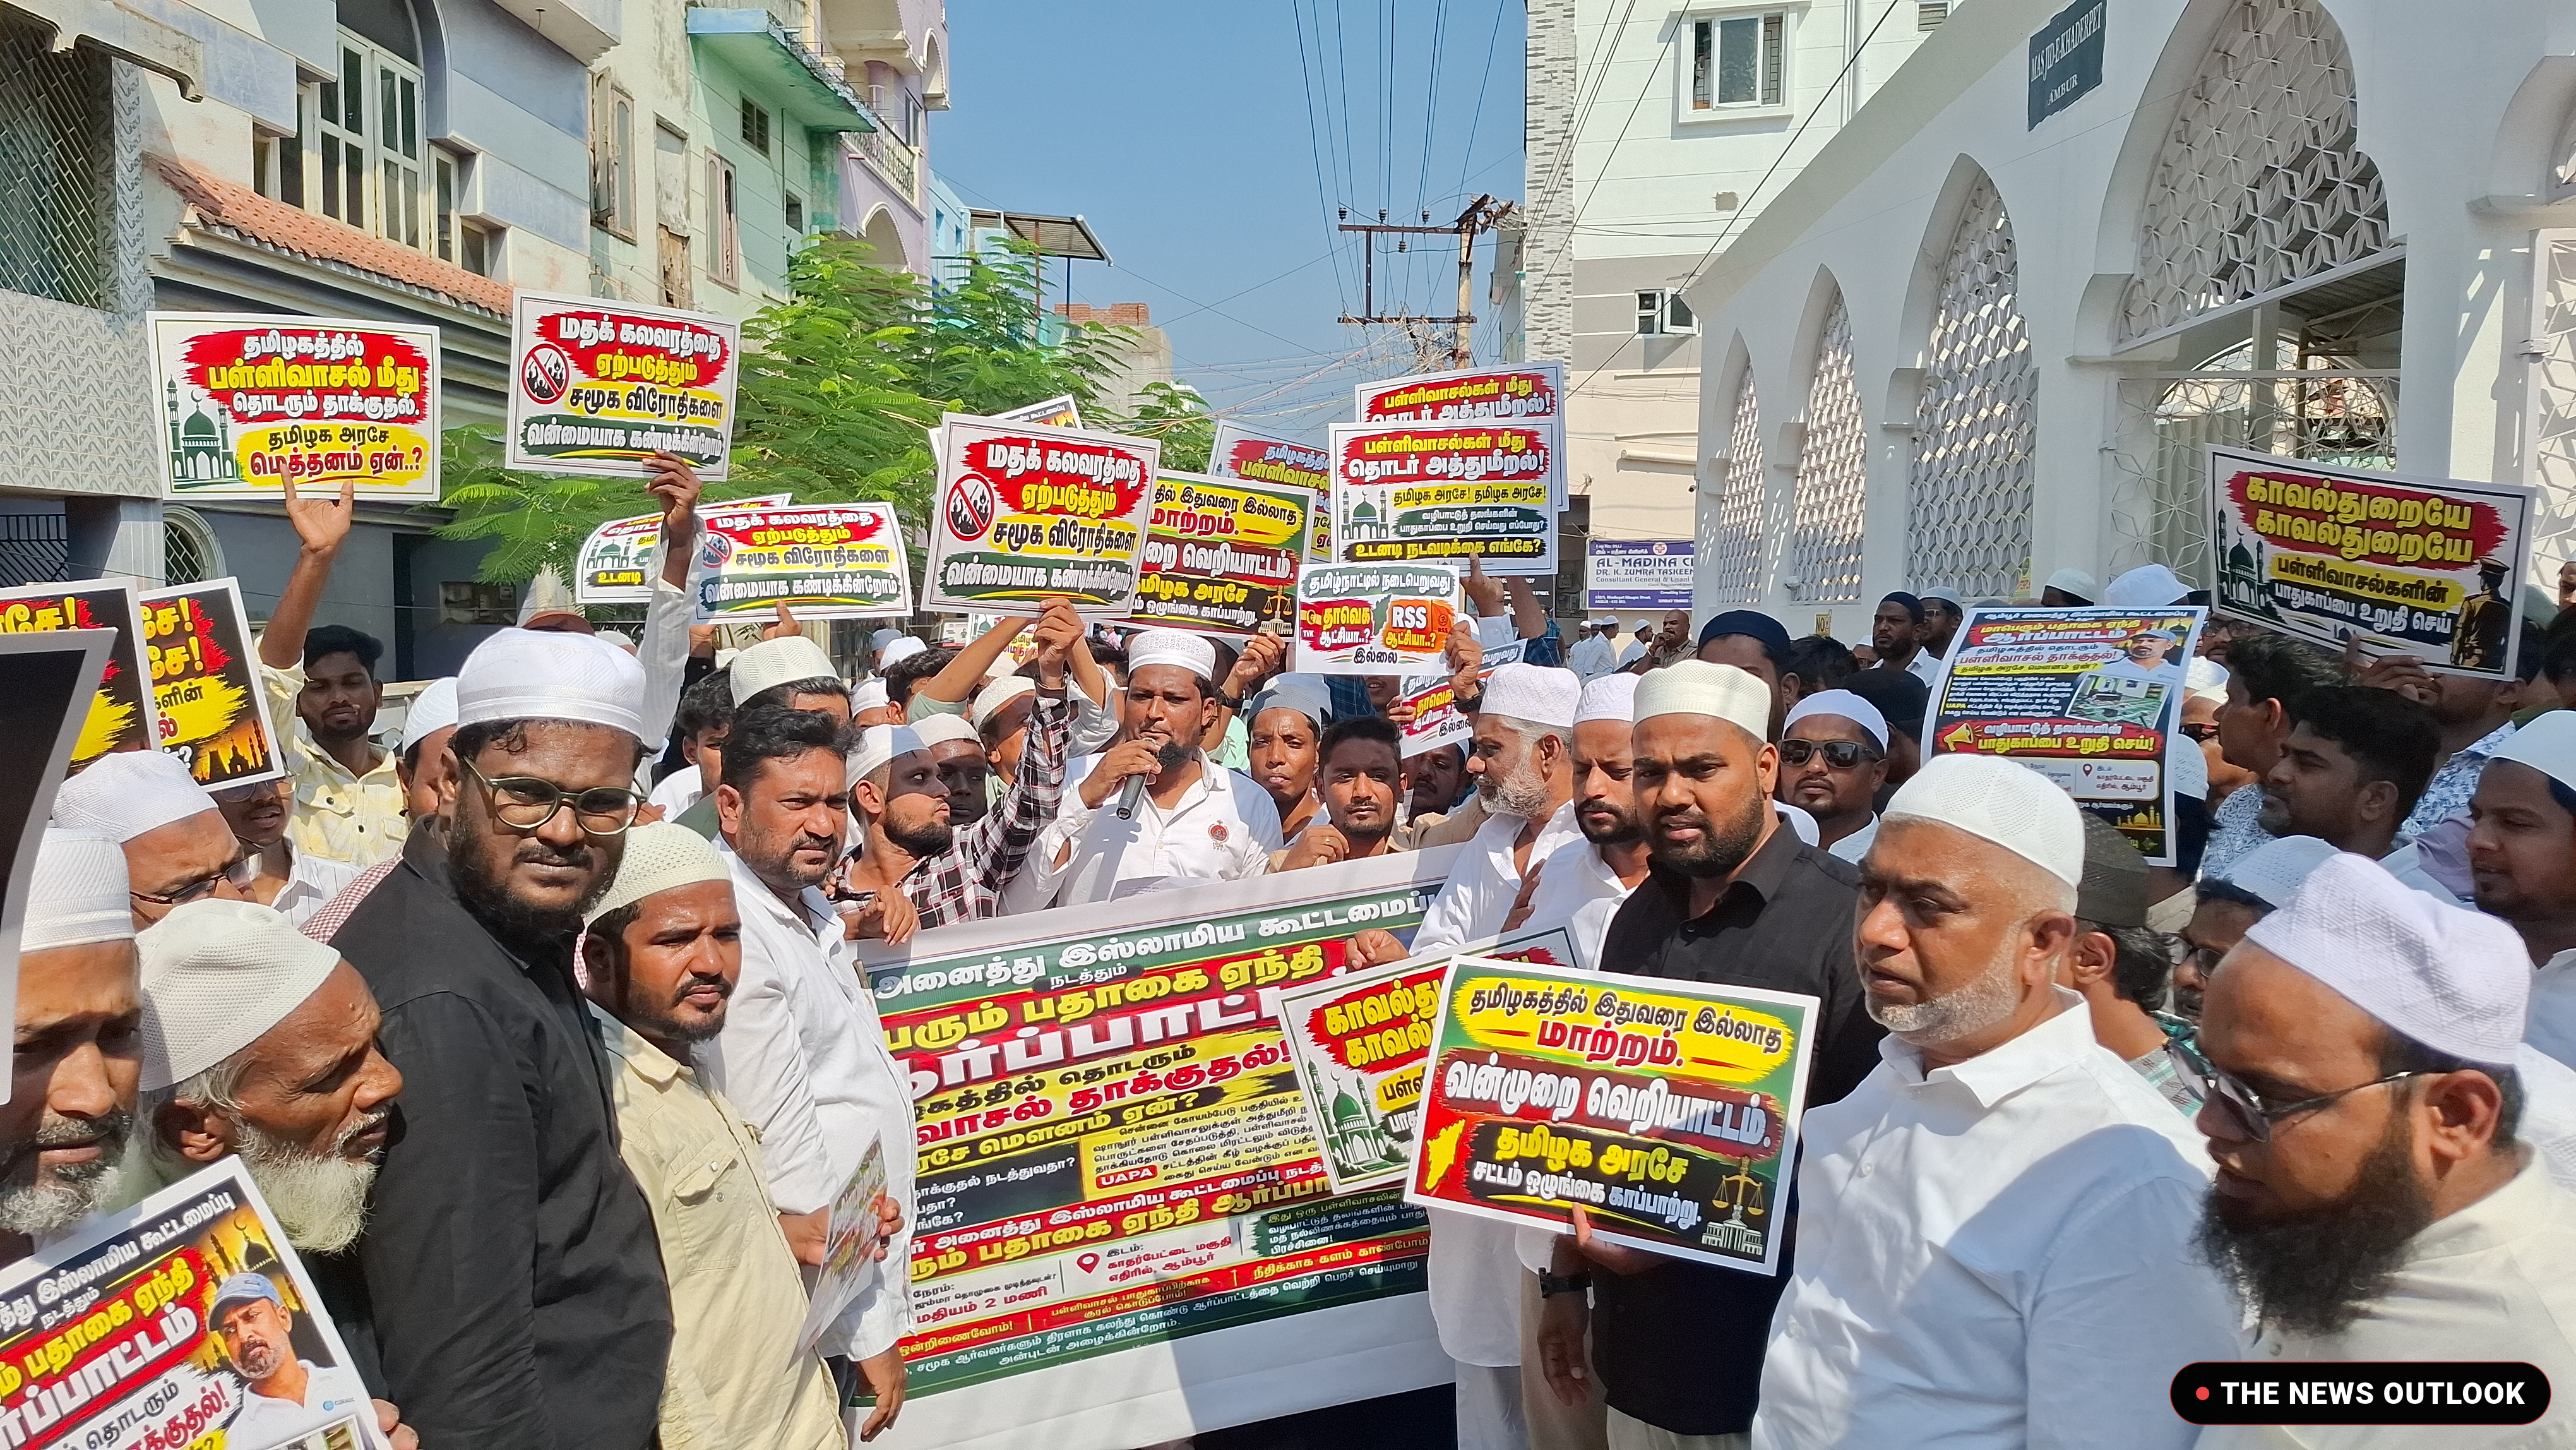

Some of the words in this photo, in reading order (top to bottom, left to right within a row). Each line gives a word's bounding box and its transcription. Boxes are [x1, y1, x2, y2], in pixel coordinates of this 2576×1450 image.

[2031, 2, 2102, 82] MASJID-E-KHADERPET
[2047, 74, 2078, 105] AMBUR
[244, 330, 364, 360] தமிழகத்தில்
[559, 315, 615, 348] மதக்
[620, 324, 722, 362] கலவரத்தை
[208, 356, 371, 390] பள்ளிவாசல்
[377, 355, 420, 395] மீது
[595, 349, 698, 387] ஏற்படுத்தும்
[232, 390, 317, 417] தொடரும்
[323, 390, 420, 419] தாக்குதல்.
[569, 386, 620, 414] சமூக
[626, 385, 724, 421] விரோதிகளை
[1385, 378, 1500, 409] பள்ளிவாசல்கள்
[1505, 376, 1532, 396] மீது
[1438, 392, 1551, 420] அத்துமீறல்!
[268, 425, 333, 451] தமிழக
[339, 426, 389, 444] அரசே
[527, 417, 626, 446] வன்மையாக
[630, 424, 724, 460] கண்டிக்கின்றோம்
[1364, 431, 1491, 453] பள்ளிவாசல்கள்
[1498, 431, 1525, 452] மீது
[251, 445, 363, 477] மெத்தனம்
[987, 440, 1042, 477] மதக்
[1046, 450, 1141, 488] கலவரத்தை
[1348, 453, 1419, 482] தொடர்
[1425, 450, 1544, 480] அத்துமீறல்!
[1022, 477, 1117, 518] ஏற்படுத்தும்
[1180, 487, 1239, 513] இதுவரை
[1243, 497, 1297, 524] இல்லாத
[1393, 488, 1431, 506] தமிழக
[1434, 486, 1470, 500] அரசே!
[1474, 486, 1508, 503] தமிழக
[1513, 486, 1546, 499] அரசே!
[2246, 475, 2472, 530] காவல்துறையே
[717, 510, 765, 530] மதக்
[768, 510, 874, 527] கலவரத்தை
[1400, 521, 1448, 534] பாதுகாப்பை
[1450, 522, 1472, 533] உறுதி
[1474, 522, 1507, 532] செய்வது
[1422, 509, 1468, 521] வழிபாட்டுத்
[1470, 510, 1517, 520] தலங்களின்
[753, 524, 852, 545] ஏற்படுத்தும்
[993, 522, 1044, 551] சமூக
[1048, 518, 1136, 556] விரோதிகளை
[1356, 542, 1402, 557] உடனடி
[1407, 539, 1485, 559] நடவடிக்கை
[1489, 539, 1541, 553] எங்கே?
[2256, 508, 2473, 563] காவல்துறையே
[736, 549, 779, 568] சமூக
[785, 546, 890, 568] விரோதிகளை
[947, 554, 1047, 587] வன்மையாக
[598, 572, 641, 585] உடனடி
[705, 575, 789, 604] வன்மையாக
[793, 573, 897, 600] கண்டிக்கின்றோம்
[1195, 582, 1248, 603] அரசே
[1309, 570, 1380, 596] தமிழ்நாட்டில்
[1381, 572, 1451, 597] நடைபெறுவது
[2277, 556, 2449, 604] பள்ளிவாசல்களின்
[1147, 599, 1198, 615] ஒழுங்கை
[1392, 606, 1427, 628] RSS
[2274, 582, 2354, 617] பாதுகாப்பை
[2359, 604, 2407, 633] உறுதி
[2412, 611, 2451, 634] செய்
[1977, 645, 2044, 654] தமிழகத்தில்
[2049, 644, 2098, 652] தொடரும்
[1982, 628, 2127, 644] ஆர்ப்பாட்டம்
[1354, 646, 1398, 665] இல்லை
[1960, 652, 2044, 664] பள்ளிவாசல்
[1978, 735, 2061, 753] பாதுகாப்பை
[2066, 736, 2109, 753] உறுதி
[2113, 735, 2154, 752] செய்!
[1984, 722, 2051, 736] வழிபாட்டுத்
[2053, 722, 2122, 734] தலங்களின்
[874, 955, 1047, 999] அனைத்து
[1058, 921, 1245, 968] இஸ்லாமிய
[1023, 968, 1208, 1023] பதாகை
[1220, 944, 1324, 991] ஏந்தி
[1051, 963, 1127, 990] நடத்தும்
[1469, 981, 1587, 1017] தமிழகத்தில்
[1594, 992, 1688, 1033] இதுவரை
[1693, 1006, 1782, 1053] இல்லாத
[1536, 1019, 1684, 1068] மாற்றம்.
[1059, 1043, 1196, 1086] தொடரும்
[1070, 1041, 1292, 1116] தாக்குதல்!
[1123, 1092, 1199, 1127] ஏன்?
[1174, 1107, 1236, 1125] கோயம்பேடு
[1241, 1097, 1288, 1113] பகுதியில்
[1445, 1052, 1582, 1122] வன்முறை
[1586, 1077, 1771, 1148] வெறியாட்டம்.
[1094, 1142, 1167, 1163] பொருட்களை
[1244, 1115, 1306, 1133] பள்ளிவாசல்
[1142, 1117, 1241, 1142] பள்ளிவாசலுக்குள்
[1095, 1153, 1167, 1175] தாக்கியதோடு
[1220, 1131, 1273, 1147] மிரட்டலும்
[1162, 1153, 1217, 1171] சட்டத்தின்
[1496, 1124, 1592, 1170] தமிழக
[1599, 1143, 1689, 1183] அரசே
[986, 1157, 1075, 1186] நடத்துவதா?
[1100, 1169, 1153, 1185] UAPA
[934, 1217, 1041, 1250] அனைத்து
[1049, 1192, 1166, 1226] இஸ்லாமிய
[1169, 1169, 1280, 1201] கூட்டமைப்பு
[1321, 1192, 1400, 1212] பள்ளிவாசலின்
[1473, 1159, 1522, 1187] சட்டம்
[1526, 1171, 1606, 1204] ஒழுங்கை
[1608, 1185, 1702, 1229] காப்பாற்று.
[979, 1220, 1111, 1262] பதாகை
[1120, 1195, 1200, 1236] ஏந்தி
[37, 1237, 141, 1305] இஸ்லாமிய
[141, 1189, 236, 1251] கூட்டமைப்பு
[1106, 1243, 1143, 1257] இடம்:
[1107, 1247, 1191, 1269] காதர்பேட்டை
[1162, 1252, 1215, 1271] ஆம்பூர்
[1253, 1258, 1313, 1279] நீதிக்காக
[1319, 1249, 1353, 1264] களம்
[913, 1283, 955, 1298] நேரம்:
[916, 1302, 978, 1324] மதியம்
[984, 1298, 997, 1308] 2
[1003, 1286, 1048, 1304] மணி
[954, 1285, 1001, 1300] தொழுகை
[1051, 1296, 1118, 1317] பள்ளிவாசல்
[1121, 1276, 1210, 1301] பாதுகாப்பிற்காக
[25, 1297, 134, 1379] பதாகை
[133, 1257, 194, 1317] ஏந்தி
[40, 1286, 100, 1329] நடத்தும்
[916, 1357, 950, 1372] சமூக
[955, 1336, 1042, 1364] ஆர்வலர்களும்
[1047, 1325, 1092, 1346] திரளாக
[1096, 1315, 1136, 1332] கலந்து
[1139, 1303, 1188, 1322] கொண்டு
[1193, 1285, 1279, 1312] ஆர்ப்பாட்டத்தை
[1283, 1276, 1320, 1292] வெற்றி
[1359, 1261, 1417, 1276] செய்யுமாறு
[999, 1345, 1060, 1366] அன்புடன்
[86, 1378, 179, 1448] தொடரும்
